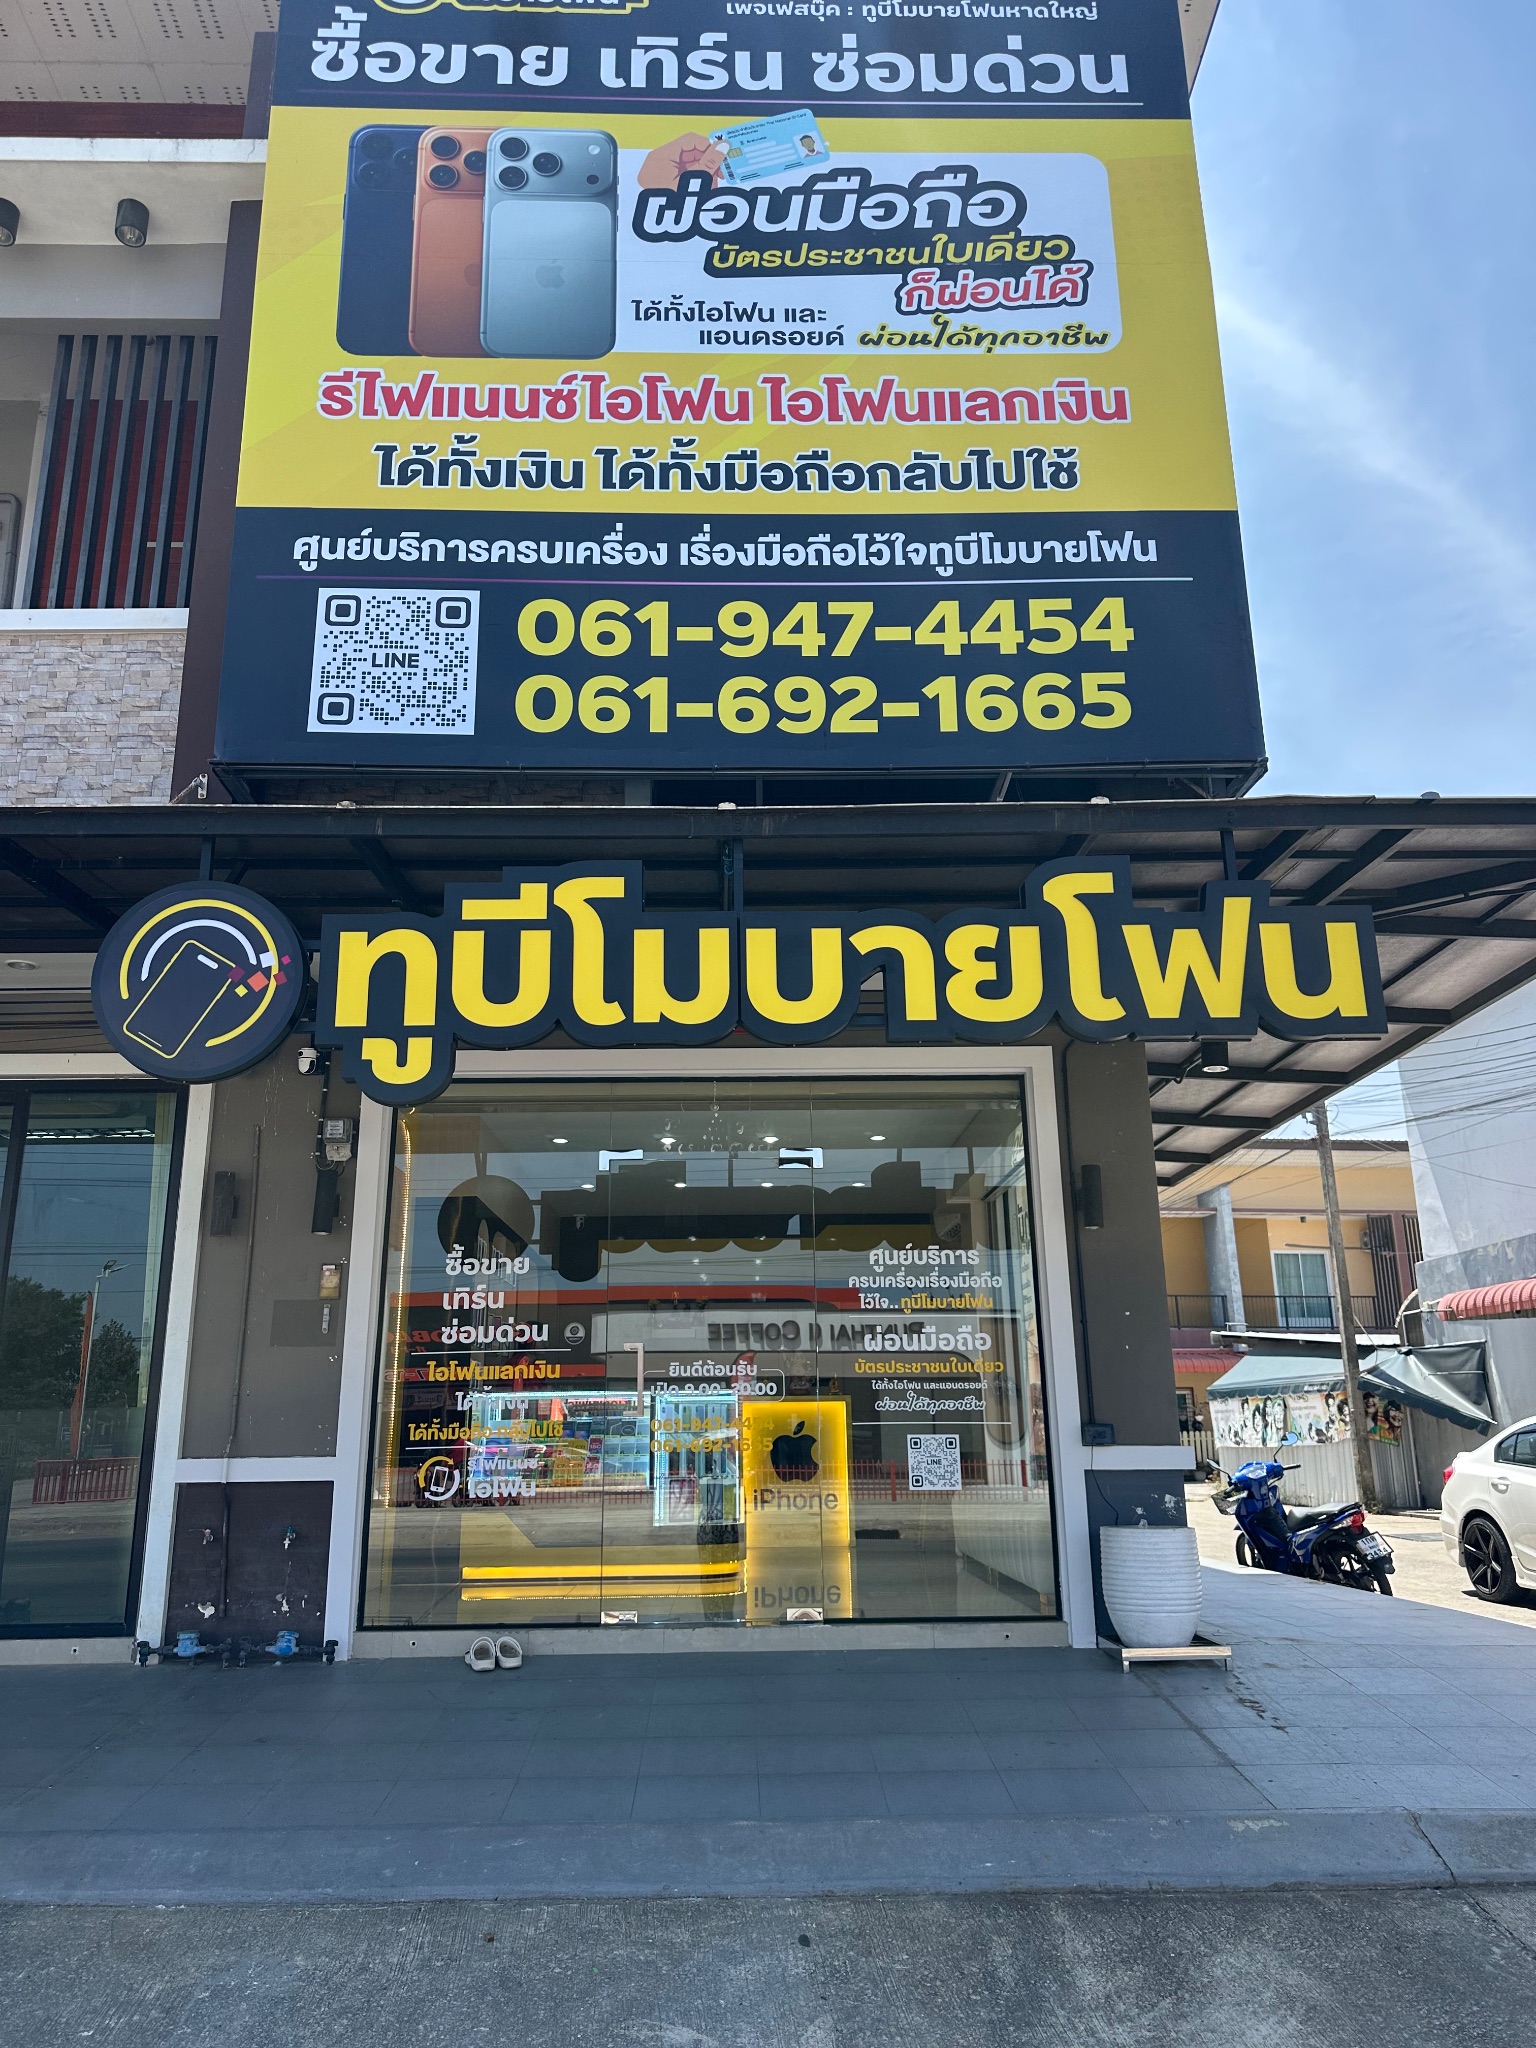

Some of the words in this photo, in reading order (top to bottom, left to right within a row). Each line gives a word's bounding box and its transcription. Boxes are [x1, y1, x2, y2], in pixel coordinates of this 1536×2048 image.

[726, 0, 841, 22] เพจเฟสบุ๊ค
[862, 1, 1098, 22] ทูบีโมบายโฟนหาดใหญ่
[311, 6, 568, 87] ซื้อขาย
[600, 32, 783, 91] เทิร์น
[812, 33, 1129, 94] ซ่อมด่วน
[642, 171, 1017, 235] ผ่อนมือถือ
[712, 234, 1070, 271] บัตรประชาชนใบเดียว
[903, 266, 1085, 309] ก็ผ่อนได้
[631, 296, 775, 324] ได้ทั้งไอโฟน
[785, 306, 827, 325] และ
[699, 325, 844, 347] แอนดรอยด์
[858, 314, 1110, 354] ผ่อนได้ทุกอาชีพ
[767, 376, 1129, 425] ไอโฟนแลกเงิน
[374, 434, 584, 488] ได้ทั้งเงิน
[595, 437, 1080, 493] ได้ทั้งมือถือกลับไปใช้
[293, 524, 668, 572] ศูนย์บริการครบเครื่อง
[680, 524, 1158, 578] เรื่องมือถือไว้ใจทูบีโมบายโฟน
[516, 597, 1136, 657] 061-947-4454
[371, 651, 420, 670] LINE
[514, 673, 1133, 735] 061-692-1665
[333, 870, 1368, 1085] ทูบีโมบายโฟน
[445, 1244, 530, 1276] ซื้อขาย
[869, 1243, 979, 1272] ศูนย์บริการ
[849, 1267, 1003, 1288] ครบเครื่องเรื่องมือถือ
[442, 1284, 504, 1310] เทิร์น
[901, 1293, 993, 1314] ทูบีโมบายโฟน
[441, 1317, 549, 1344] ซ่อมด่วน
[864, 1325, 991, 1351] ผ่อนมือถือ
[426, 1360, 561, 1382] ไอโฟนแลกเงิน
[669, 1360, 757, 1377] ยินดีต้อนรับ
[855, 1357, 1004, 1373] บัตรประชาชนใบเดียว
[685, 1383, 720, 1396] 900
[872, 1378, 921, 1390] ได้ทั้งไอโฟน
[923, 1380, 988, 1390] และแอนดรอยด์
[875, 1391, 986, 1414] ผ่อนได้ทุกอาชีพ
[926, 1458, 943, 1466] LINE
[467, 1476, 536, 1499] ไอโฟน
[753, 1488, 838, 1511] iPhone
